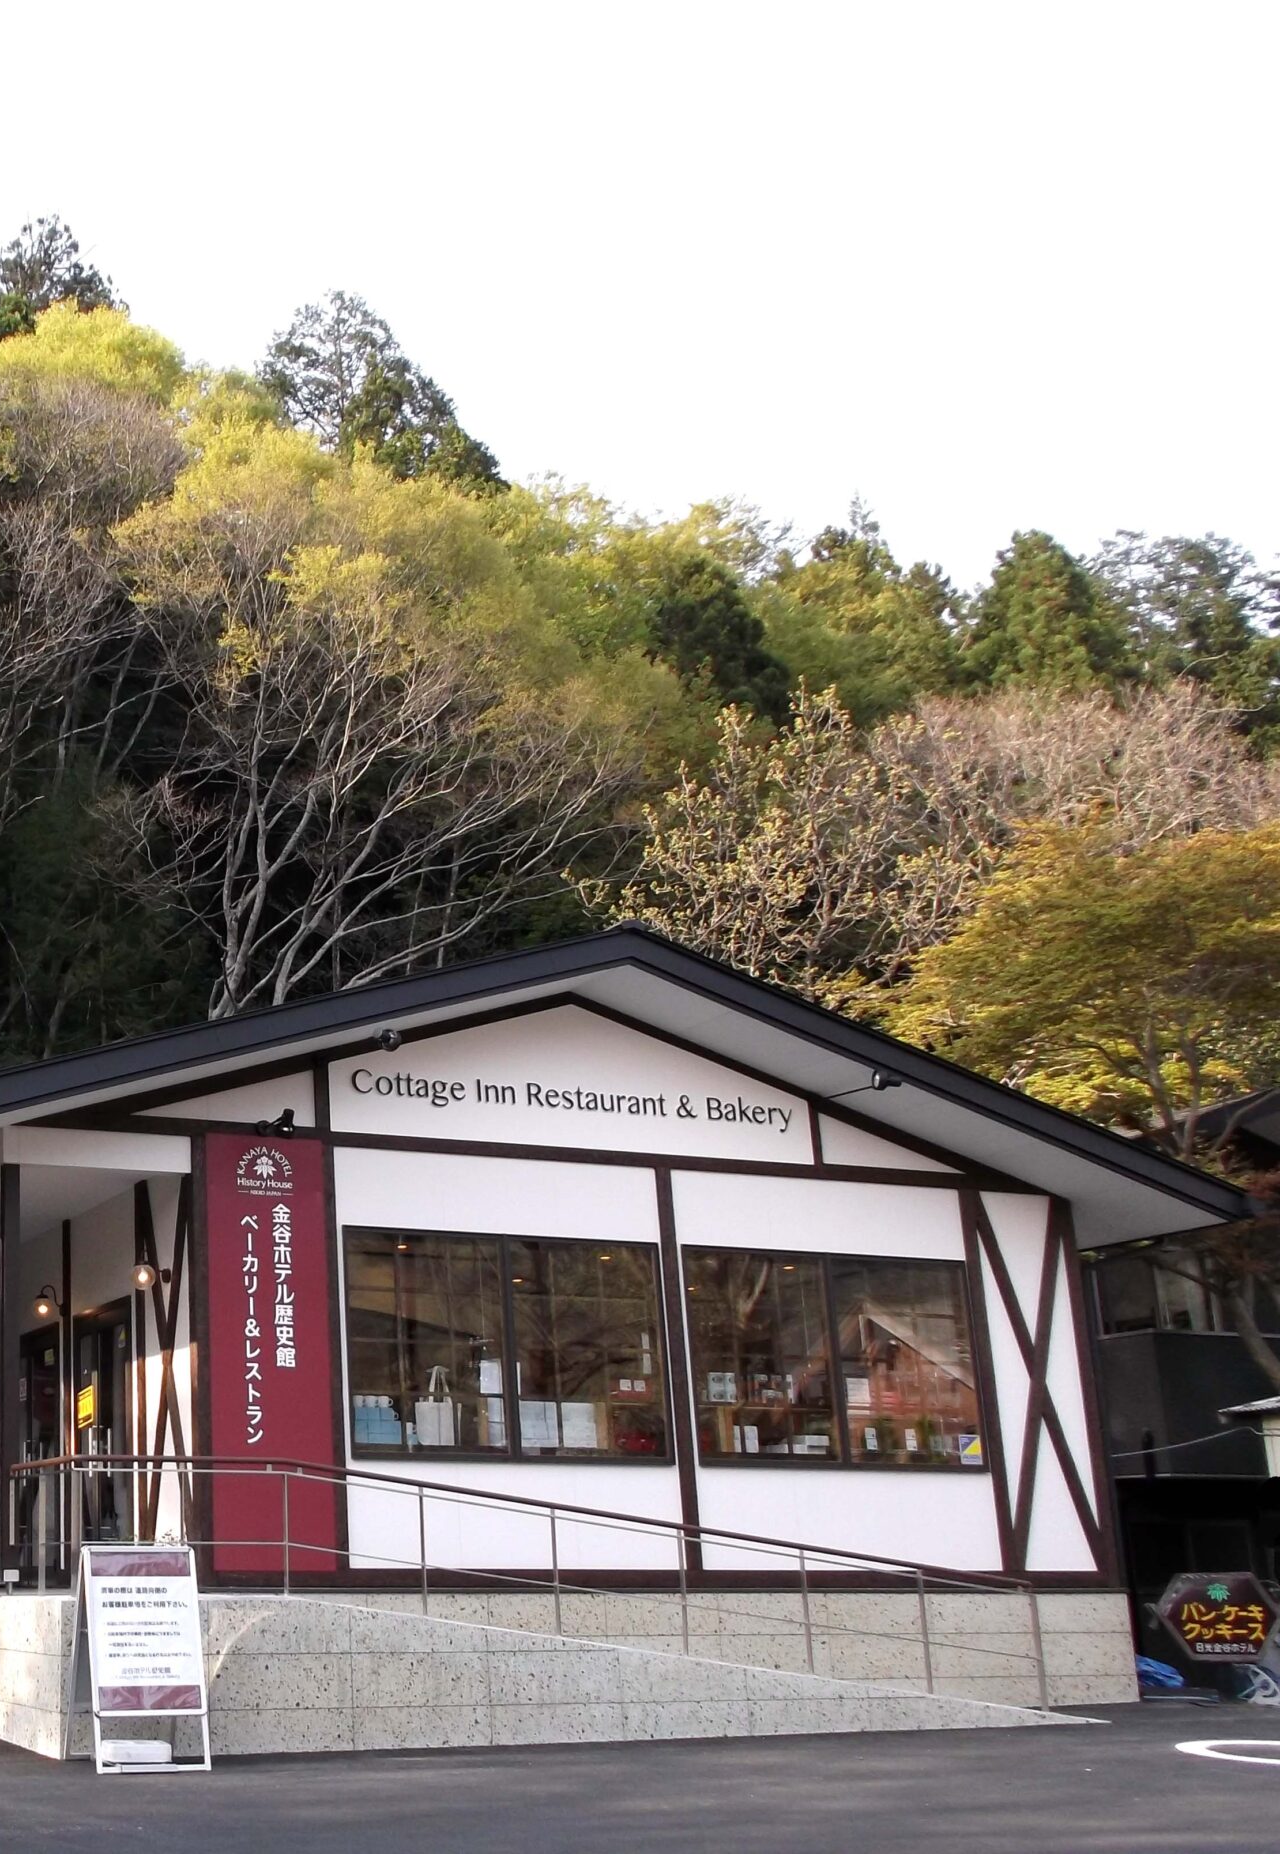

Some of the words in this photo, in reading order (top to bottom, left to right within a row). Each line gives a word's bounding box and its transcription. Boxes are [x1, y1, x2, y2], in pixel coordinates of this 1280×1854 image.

[351, 1068, 467, 1107] Cottage
[476, 1079, 517, 1106] Inn
[526, 1082, 668, 1118] Restaurant
[676, 1094, 698, 1118] &
[706, 1097, 793, 1132] Bakery
[236, 1146, 268, 1175] KANAYA
[270, 1148, 293, 1178] HOTEL
[237, 1177, 267, 1190] History
[267, 1179, 293, 1190] House
[271, 1203, 296, 1368] 金谷ホテル歴史館
[1183, 1623, 1266, 1640] クッキース
